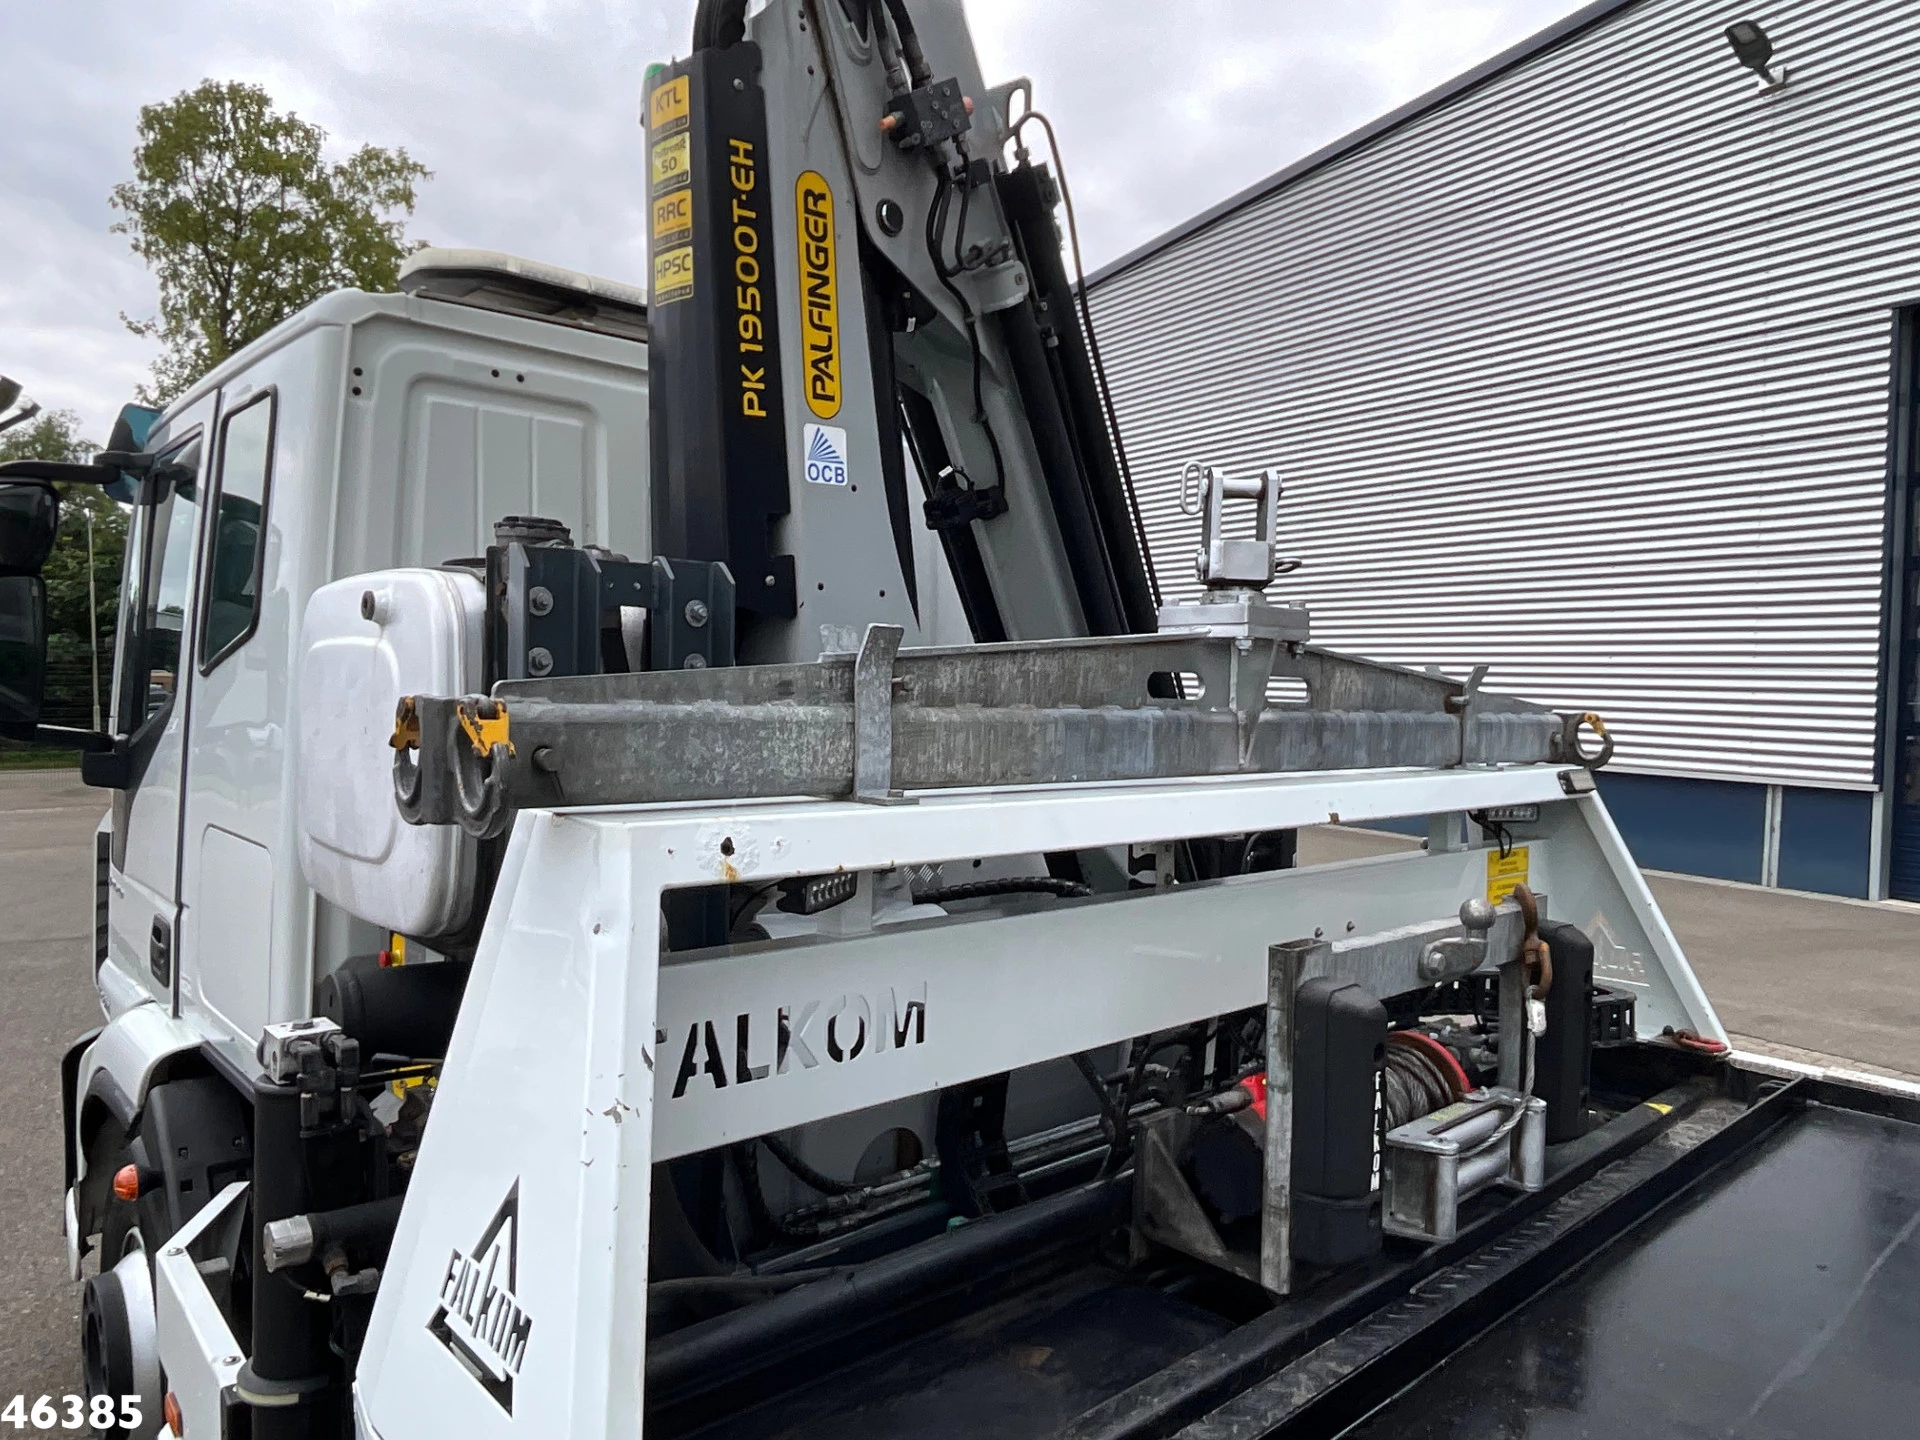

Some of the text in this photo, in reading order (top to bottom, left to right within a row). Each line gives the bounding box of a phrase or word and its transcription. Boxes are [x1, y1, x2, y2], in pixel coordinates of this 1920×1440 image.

[655, 86, 682, 113] KTL
[657, 198, 687, 225] RRC
[655, 253, 691, 280] HPSC
[803, 188, 836, 403] PALFINGER
[741, 364, 767, 417] PK
[808, 462, 845, 484] OCB
[656, 982, 927, 1099] ALKOM
[1370, 1070, 1382, 1192] FALKOM
[439, 1244, 533, 1375] FALKOM
